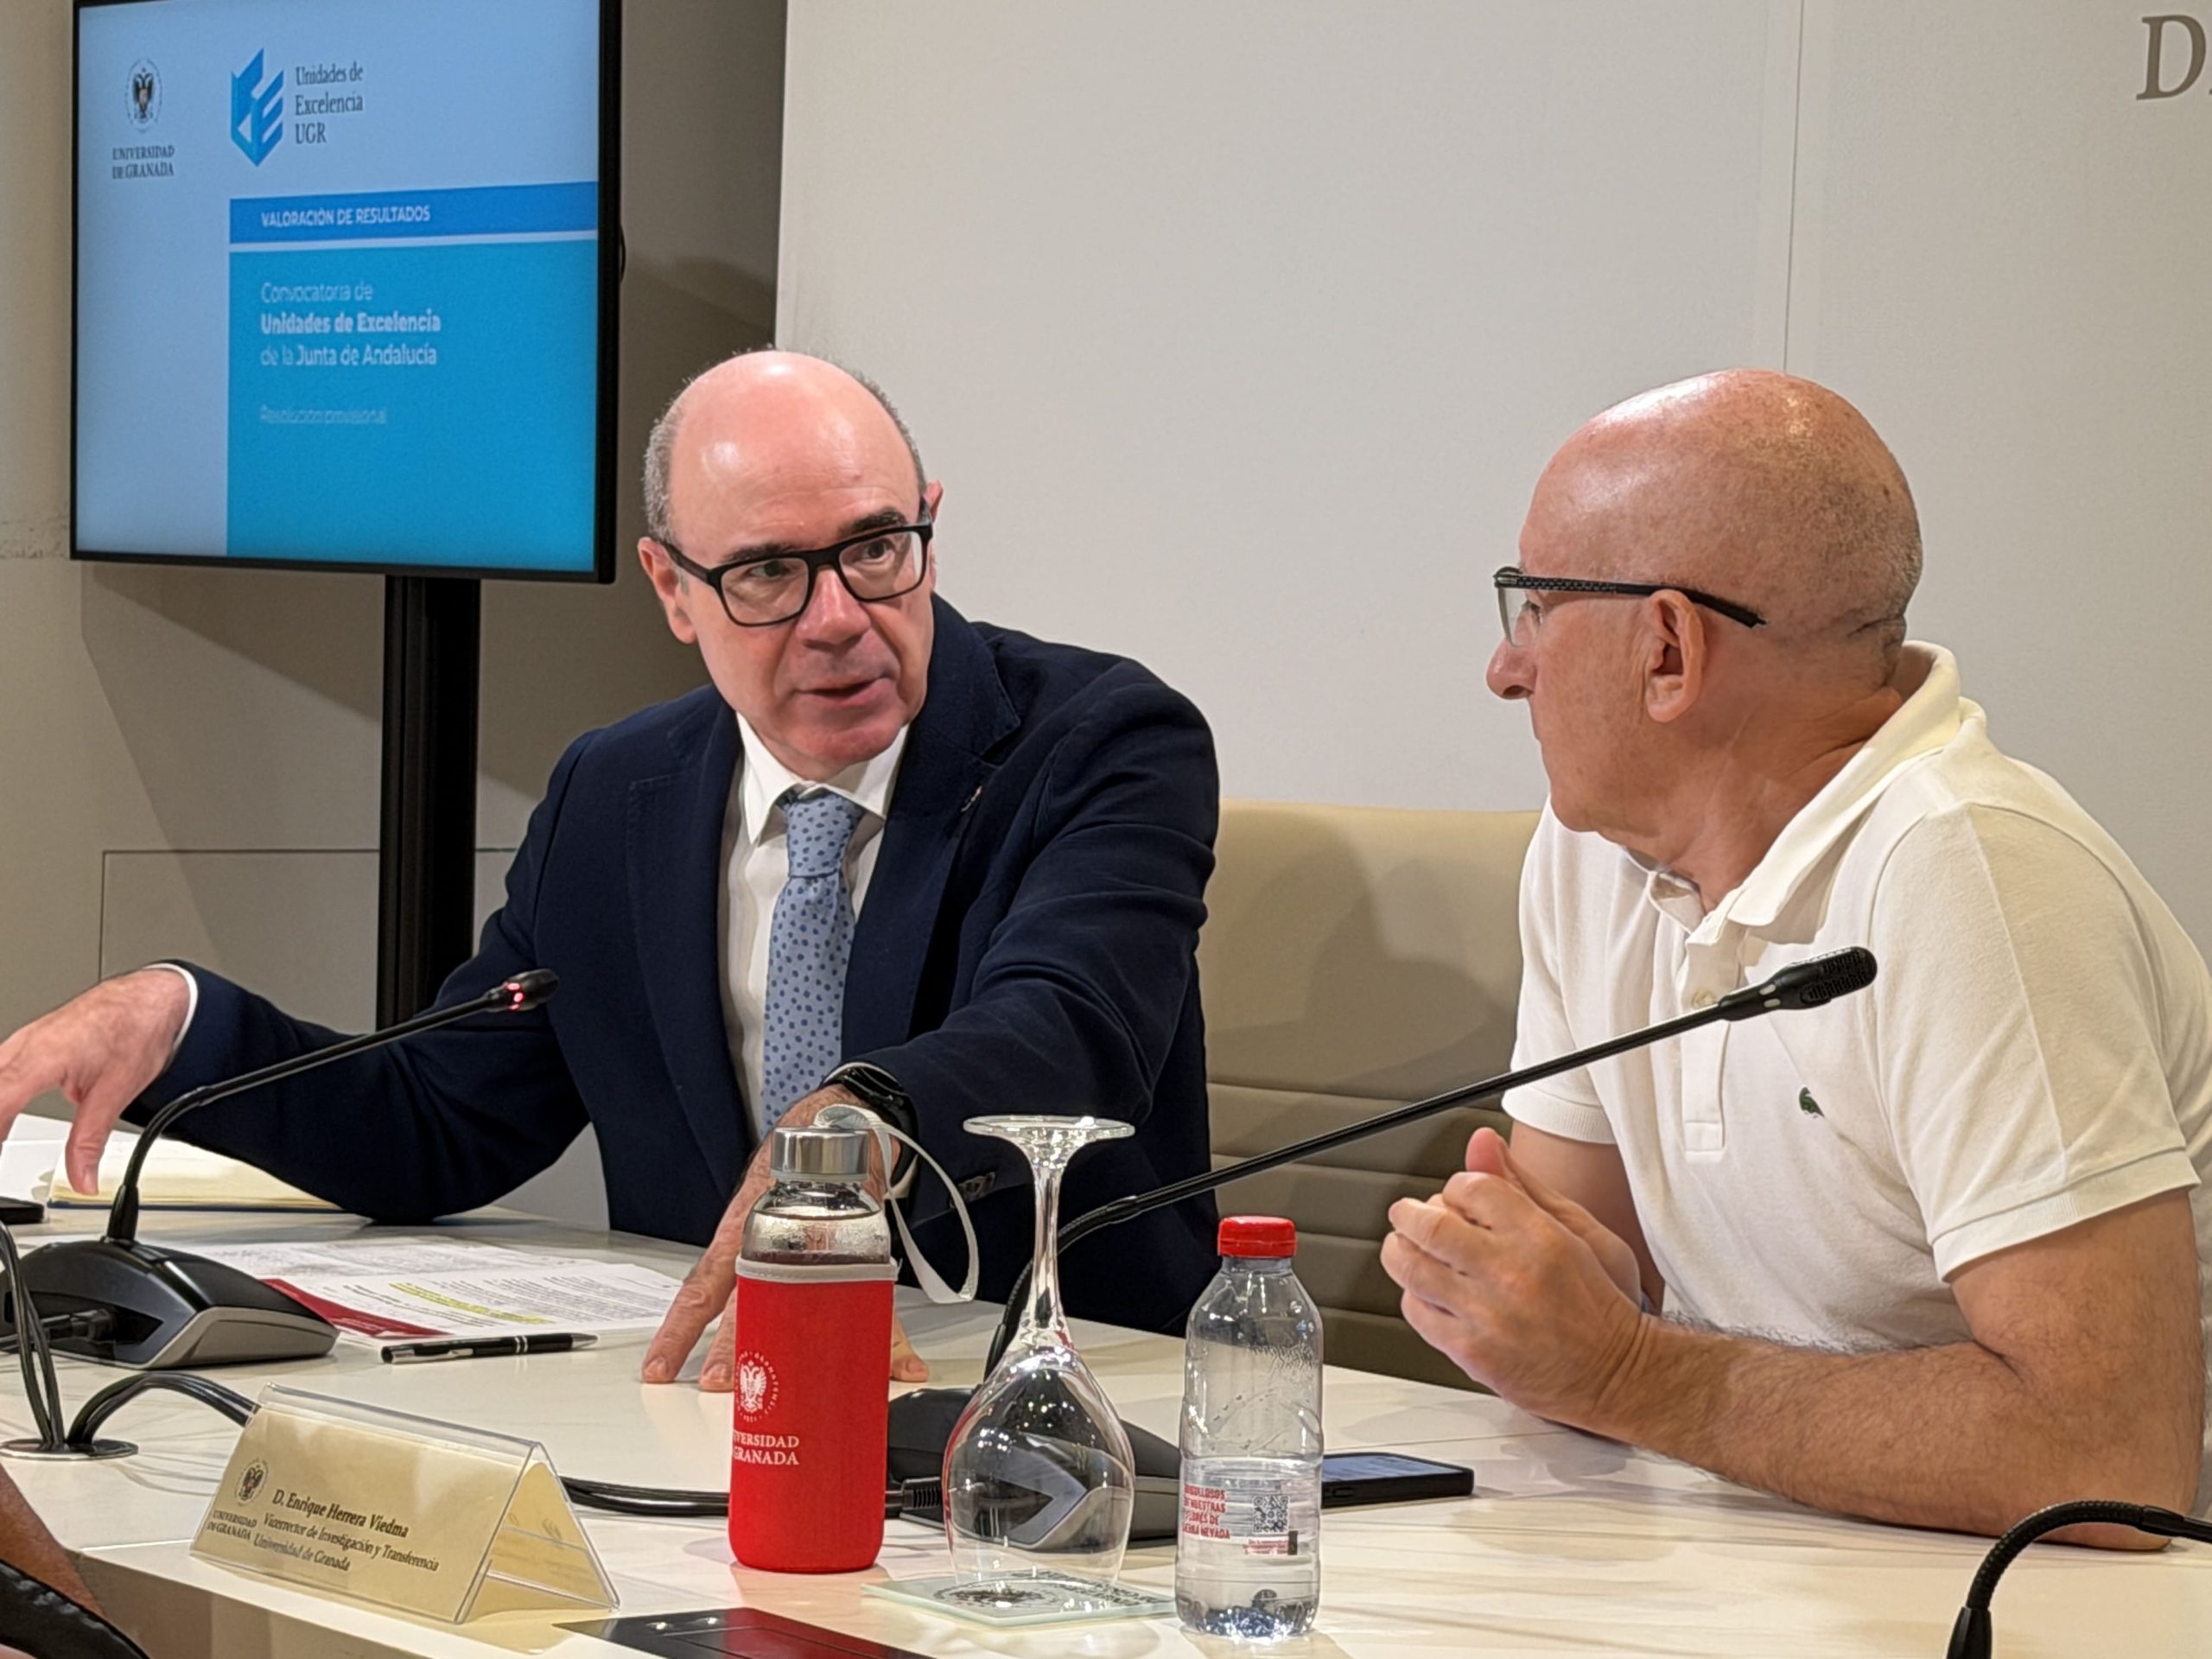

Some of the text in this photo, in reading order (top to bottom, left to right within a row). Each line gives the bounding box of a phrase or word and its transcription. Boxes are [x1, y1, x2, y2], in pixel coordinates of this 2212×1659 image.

[296, 61, 363, 86] Unidades de
[296, 92, 363, 116] Excelencia
[296, 124, 327, 144] UGR
[112, 145, 175, 161] UNIVERSIDAD
[112, 162, 175, 179] DE GRANADA
[261, 206, 430, 227] VALORACIÓN DE RESULTADOS
[261, 281, 372, 302] Convocatoria de
[261, 308, 441, 334] Unidades de Excelencia
[261, 342, 436, 365] de la Junta de Andalucía
[272, 1489, 409, 1538] D. Enrique Herrera Viedma
[264, 1513, 308, 1535] Vicerrector
[306, 1525, 318, 1539] de
[318, 1527, 373, 1554] Investigación
[382, 1544, 439, 1572] Transferencia
[1200, 1527, 1230, 1539] NEVADA
[254, 1533, 351, 1572] Universidad de Granada
